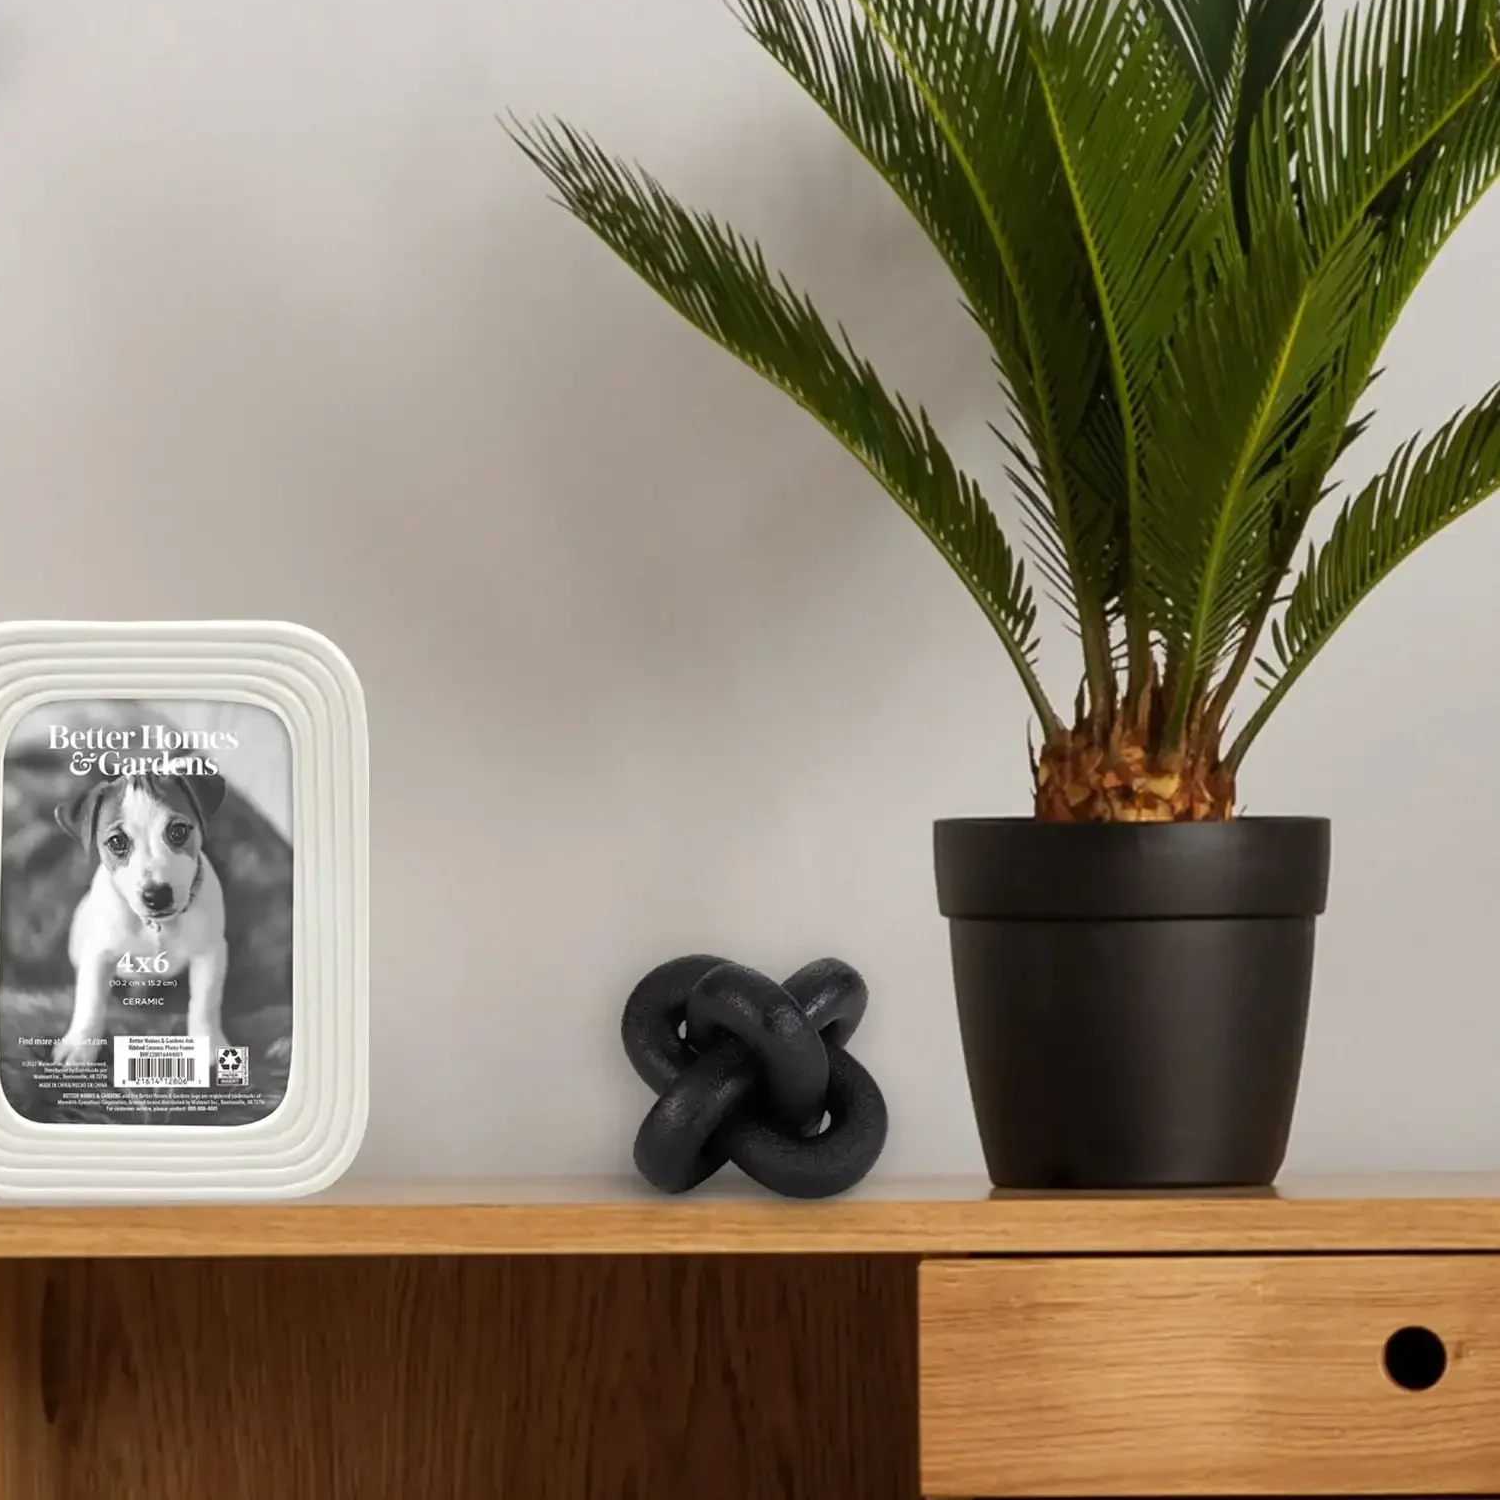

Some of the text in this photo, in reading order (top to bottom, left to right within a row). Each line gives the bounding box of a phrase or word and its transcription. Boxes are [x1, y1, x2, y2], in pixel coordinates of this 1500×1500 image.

[48, 724, 240, 750] Better Homes
[116, 951, 170, 973] 4x6
[122, 997, 164, 1006] CERAMIC
[18, 1037, 33, 1045] Find
